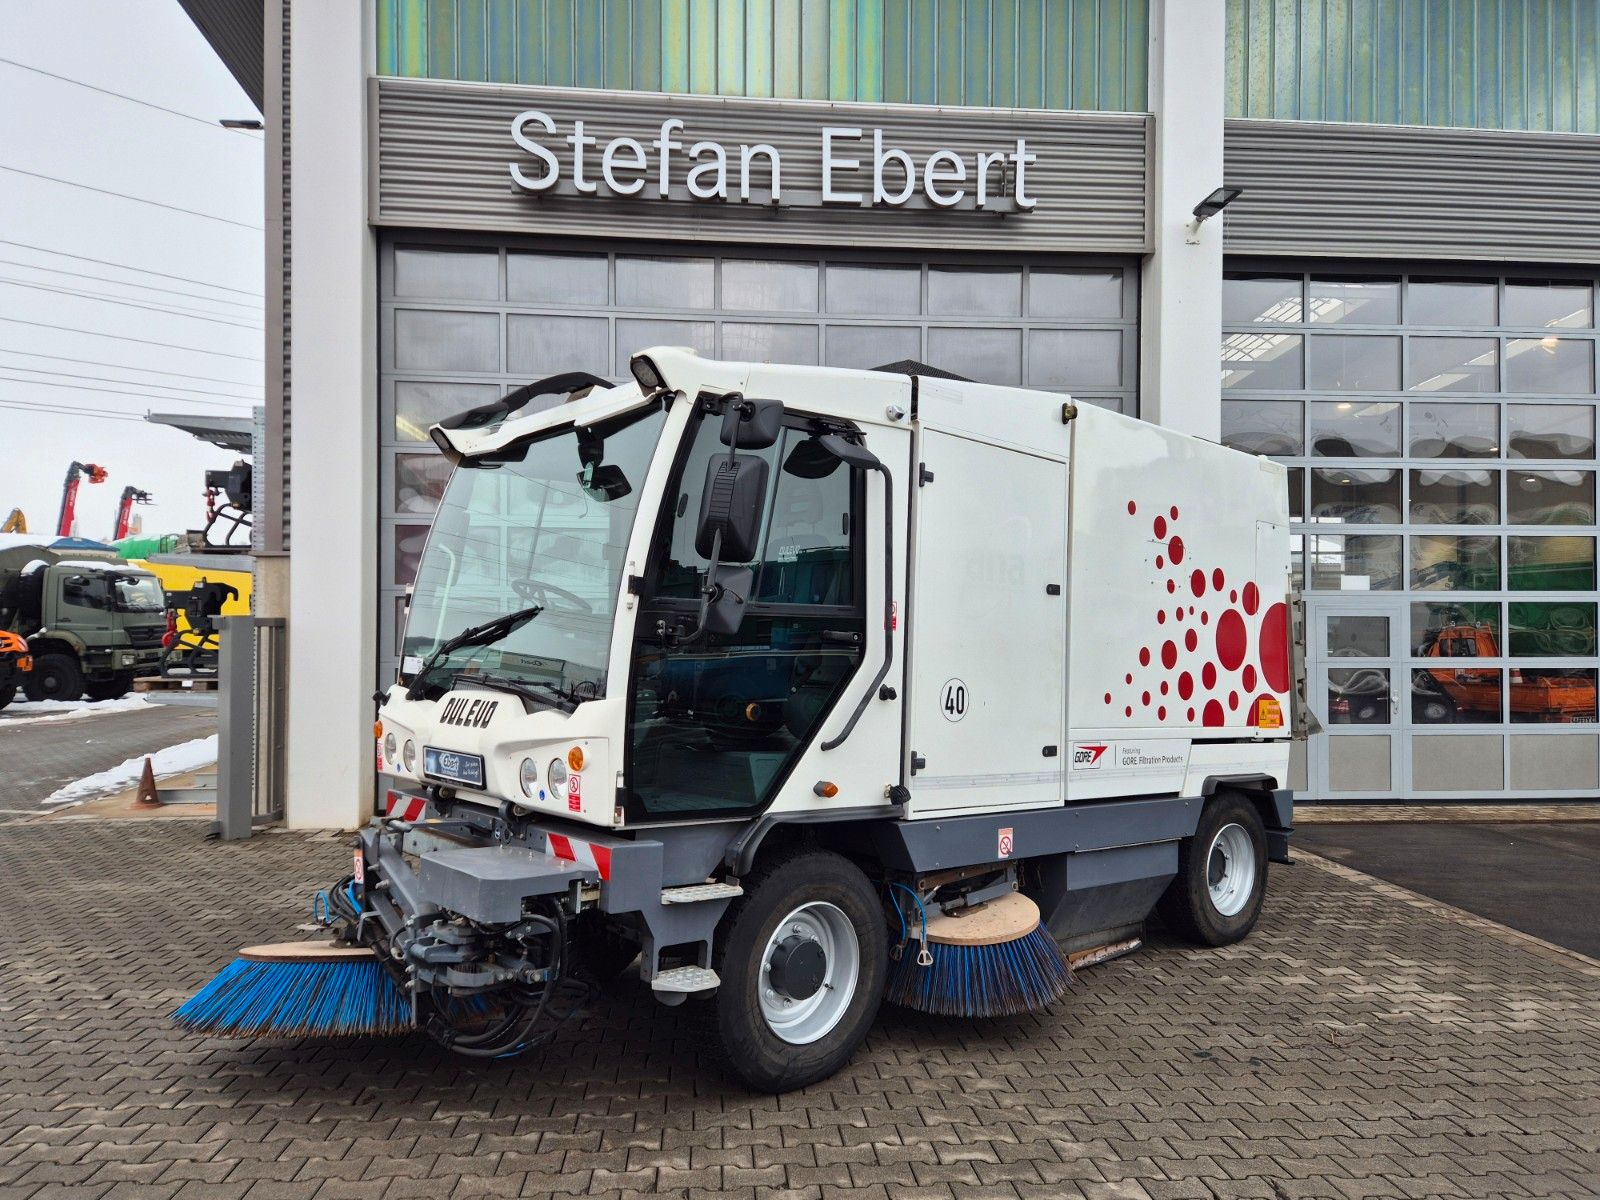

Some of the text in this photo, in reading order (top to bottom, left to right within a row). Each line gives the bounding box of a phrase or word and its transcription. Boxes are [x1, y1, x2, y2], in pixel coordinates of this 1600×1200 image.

[509, 110, 1037, 210] Stefan Ebert
[440, 697, 499, 729] DULEVO
[944, 685, 965, 715] 40
[1074, 751, 1092, 763] GORE
[1138, 755, 1161, 765] Filtration
[1161, 754, 1184, 764] Products
